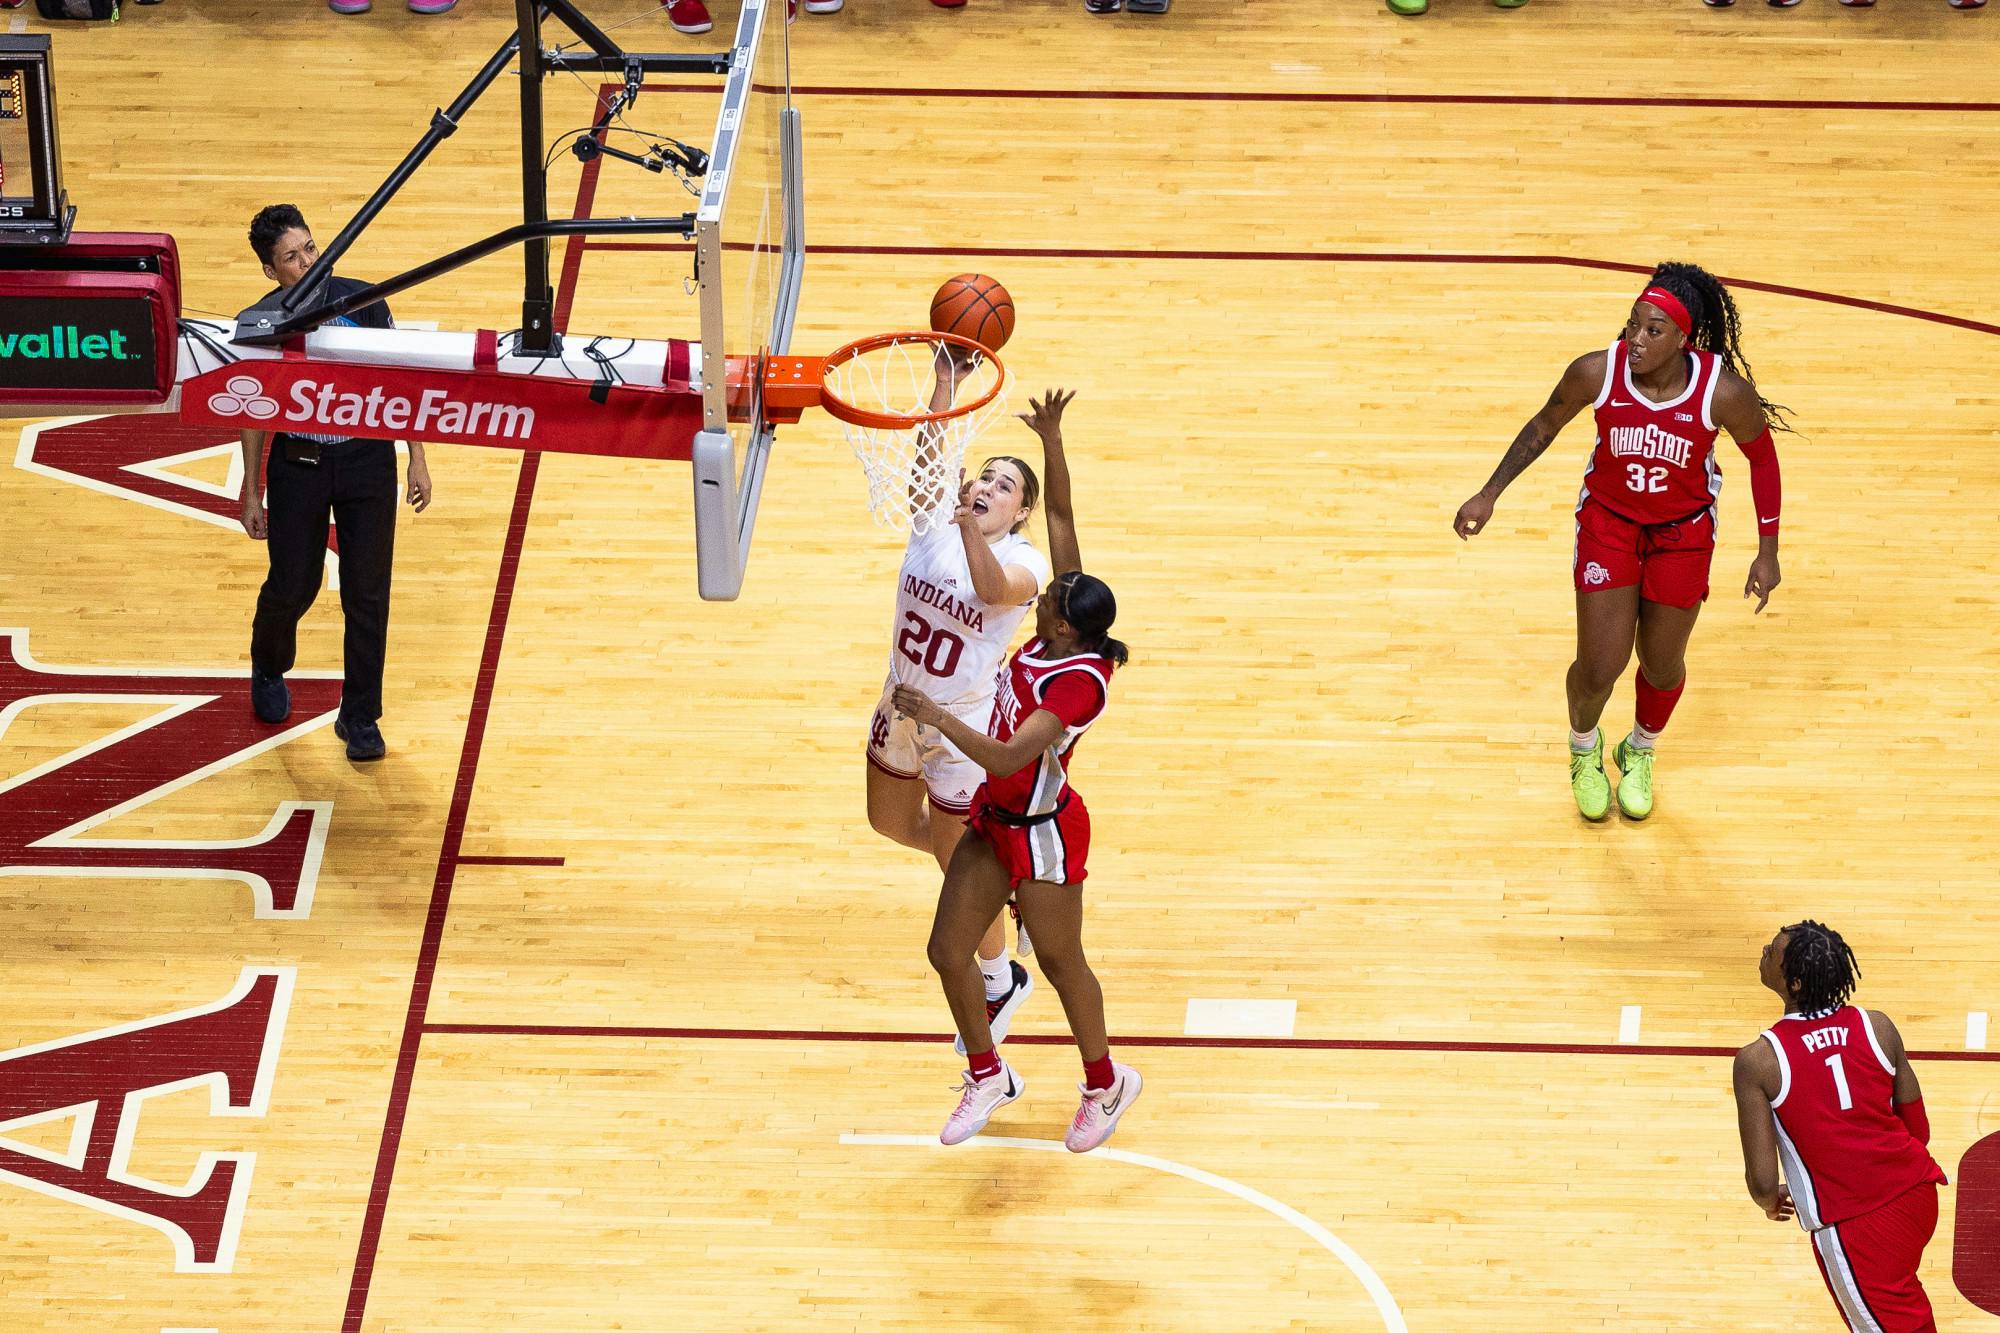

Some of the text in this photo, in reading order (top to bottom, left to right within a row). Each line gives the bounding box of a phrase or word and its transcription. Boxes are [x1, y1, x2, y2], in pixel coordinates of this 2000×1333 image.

[1626, 463, 1669, 493] 32
[903, 573, 983, 634] INDIANA
[897, 610, 965, 678] 20
[1800, 1026, 1849, 1054] PETTY
[1824, 1053, 1853, 1111] 1
